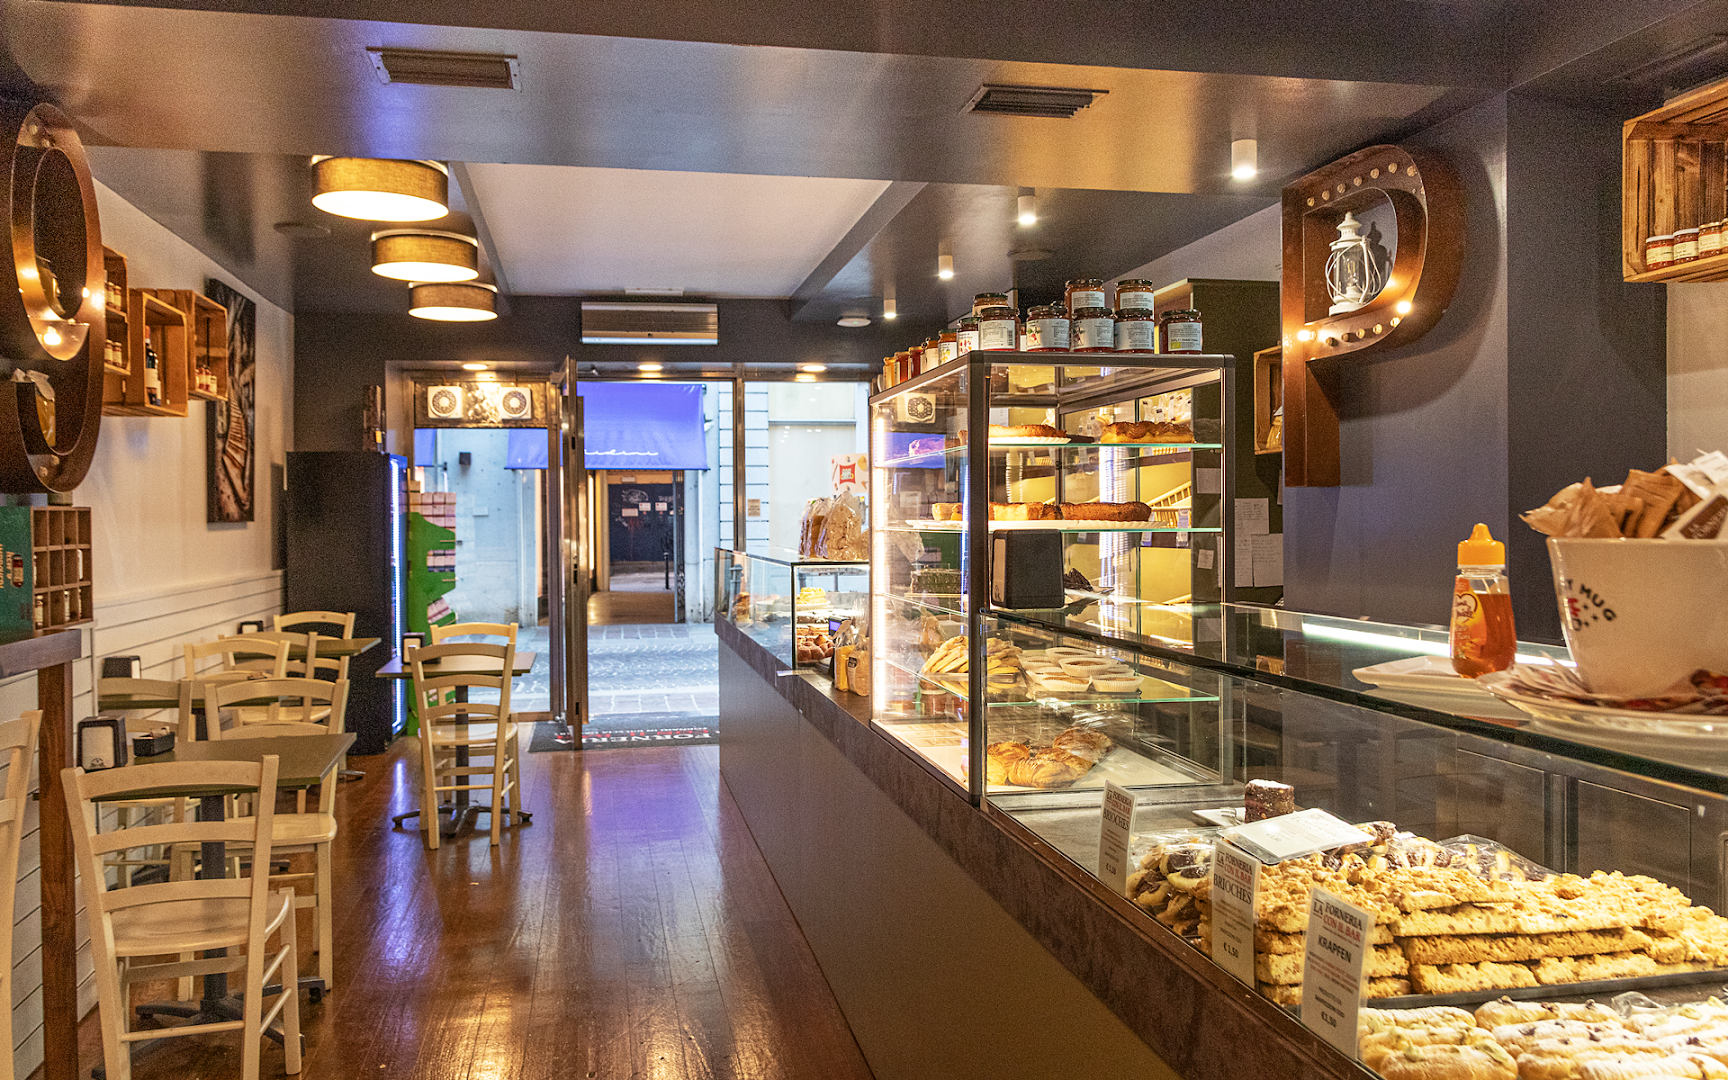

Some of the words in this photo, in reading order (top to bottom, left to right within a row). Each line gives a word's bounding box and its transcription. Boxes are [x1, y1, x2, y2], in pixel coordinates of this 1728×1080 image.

[1282, 144, 1460, 488] P
[1579, 583, 1617, 622] MUG
[1103, 807, 1130, 832] BRIOCHES
[1216, 853, 1225, 865] LA
[1225, 852, 1253, 876] FORNERIA
[1224, 863, 1235, 876] CON
[1240, 871, 1252, 885] BAR
[1213, 873, 1252, 905] BRIOCHES
[1313, 901, 1324, 916] LA
[1325, 902, 1363, 931] FORNERIA
[1323, 914, 1338, 929] CON
[1337, 921, 1345, 934] IL
[1345, 925, 1361, 943] BAR
[1317, 934, 1352, 964] KRAPFEN
